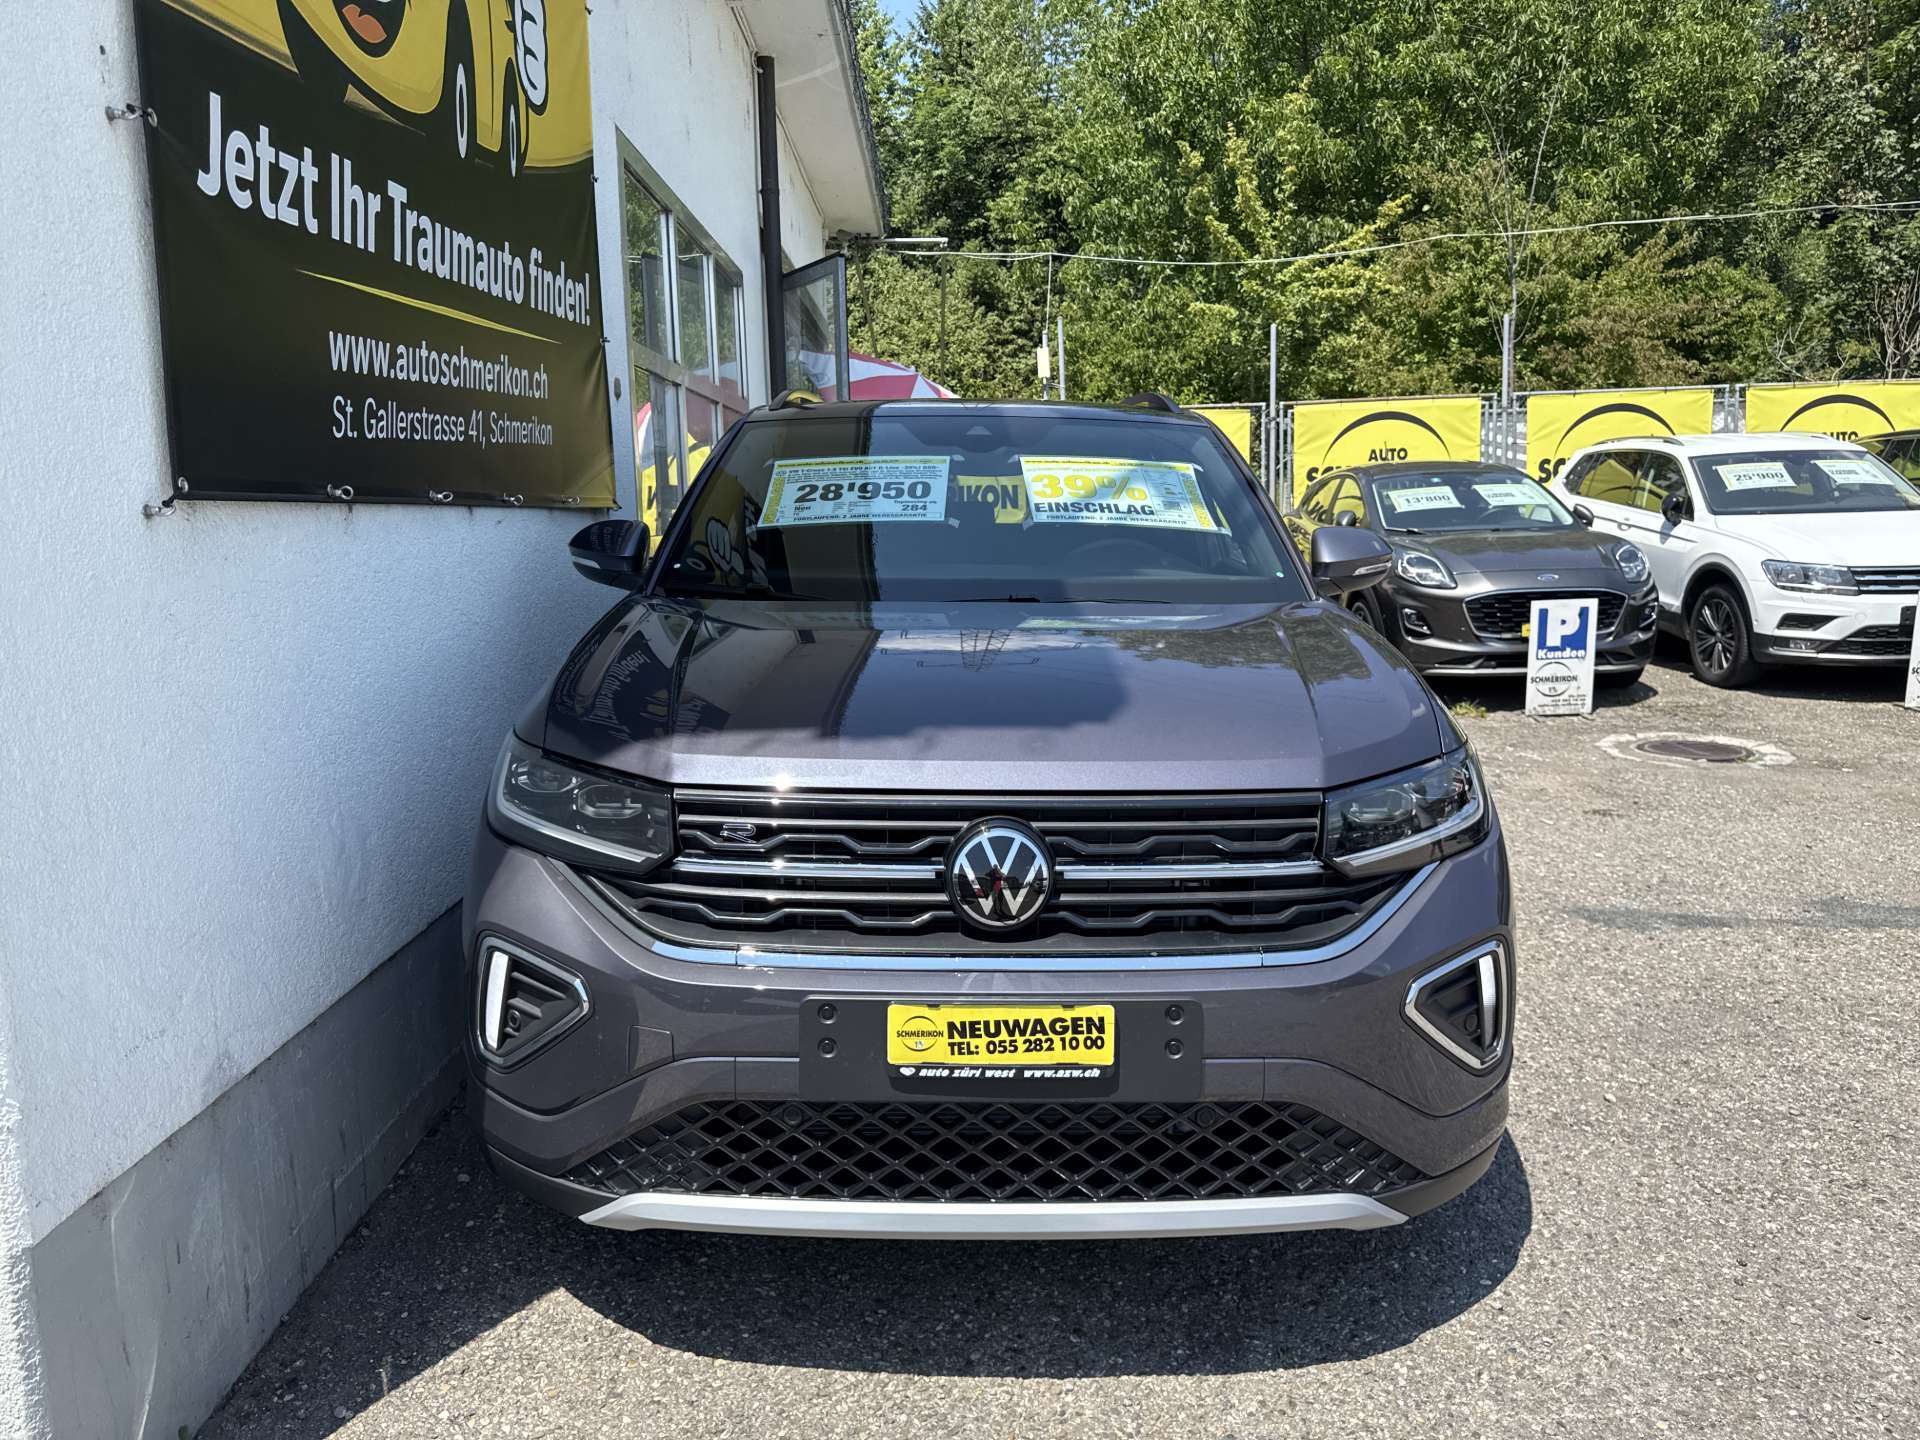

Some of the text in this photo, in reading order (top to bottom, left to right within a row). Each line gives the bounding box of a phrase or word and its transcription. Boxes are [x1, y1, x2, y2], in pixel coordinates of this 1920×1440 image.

[197, 90, 591, 326] Jetzt Ihr Traumauto finden!
[328, 330, 549, 400] www.autoschmerikon.ch
[332, 395, 553, 450] St. Gallerstrasse 41, Schmerikon
[1367, 447, 1408, 462] AUTO
[1030, 473, 1149, 501] 39%
[1733, 471, 1784, 483] 25'900
[794, 480, 932, 503] 28'950
[1034, 501, 1155, 516] EINSCHLAG
[1545, 606, 1581, 647] P
[1537, 648, 1586, 660] Kunden
[1530, 674, 1578, 685] SCHMERIKON
[896, 1029, 944, 1038] SCHMERIKON
[947, 1016, 1105, 1039] NEUWAGEN
[948, 1035, 1105, 1056] TEL: 055 282 10 00
[919, 1067, 1101, 1078] auto züri west www.azw.ch
